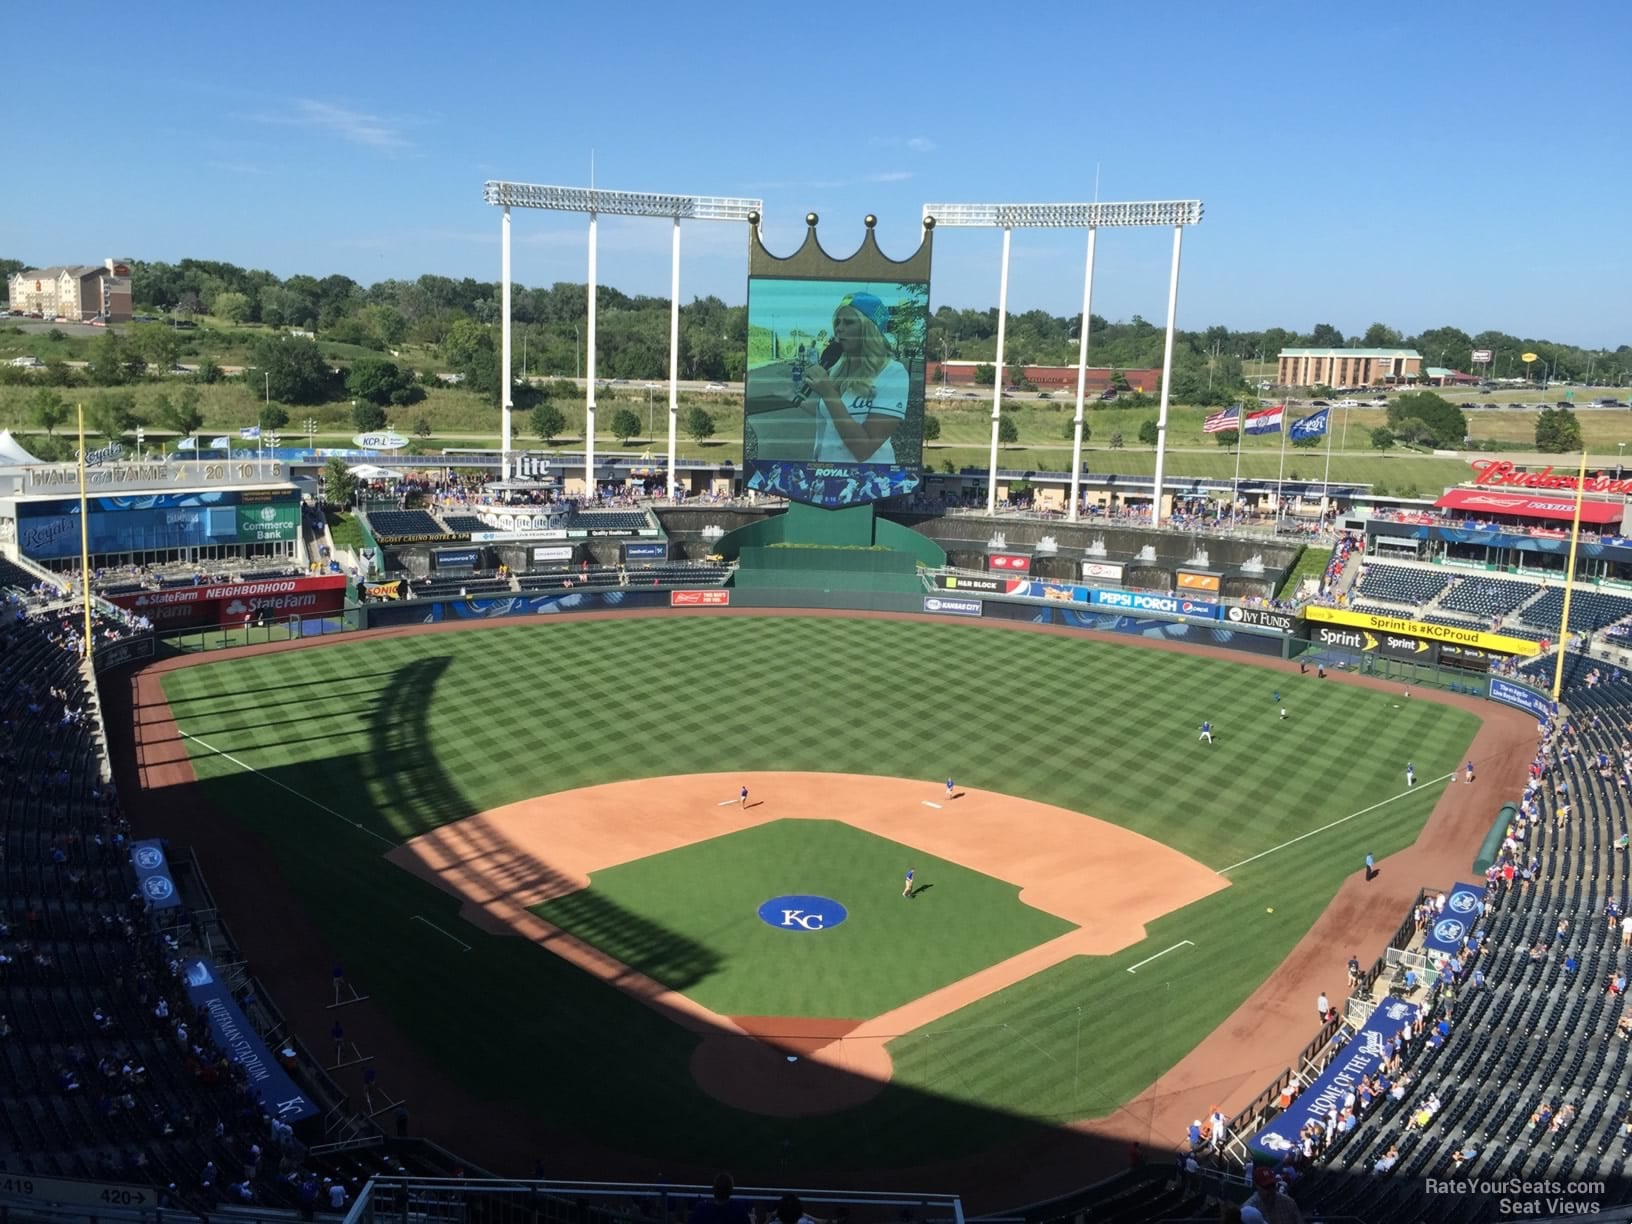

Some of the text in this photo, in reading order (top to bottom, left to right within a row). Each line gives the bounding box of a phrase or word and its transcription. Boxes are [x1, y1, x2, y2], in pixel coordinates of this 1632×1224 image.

[75, 441, 122, 468] Royals
[112, 465, 168, 482] FAME
[205, 465, 223, 480] 20
[239, 463, 253, 478] 10
[272, 463, 280, 477] 5
[515, 457, 550, 480] Lite
[815, 469, 849, 477] ROYAL
[23, 517, 74, 548] Royals
[243, 521, 293, 531] Commerce
[257, 530, 281, 540] Bank
[458, 532, 470, 540] SPA
[206, 582, 295, 599] NEIGHBORHOOD
[368, 586, 398, 595] SONIC
[1100, 592, 1176, 612] PEPSI PORCH
[1371, 617, 1479, 642] Sprint is #KCProud
[1320, 629, 1360, 648] Sprint
[1387, 637, 1415, 650] Sprint
[781, 910, 823, 930] KC
[206, 998, 270, 1082] KAUFFMAN STADIUM
[1307, 1084, 1344, 1116] HOME
[1333, 1071, 1355, 1087] OF
[1344, 1054, 1371, 1074] THE
[4, 1179, 34, 1195] 419
[101, 1189, 131, 1205] 420
